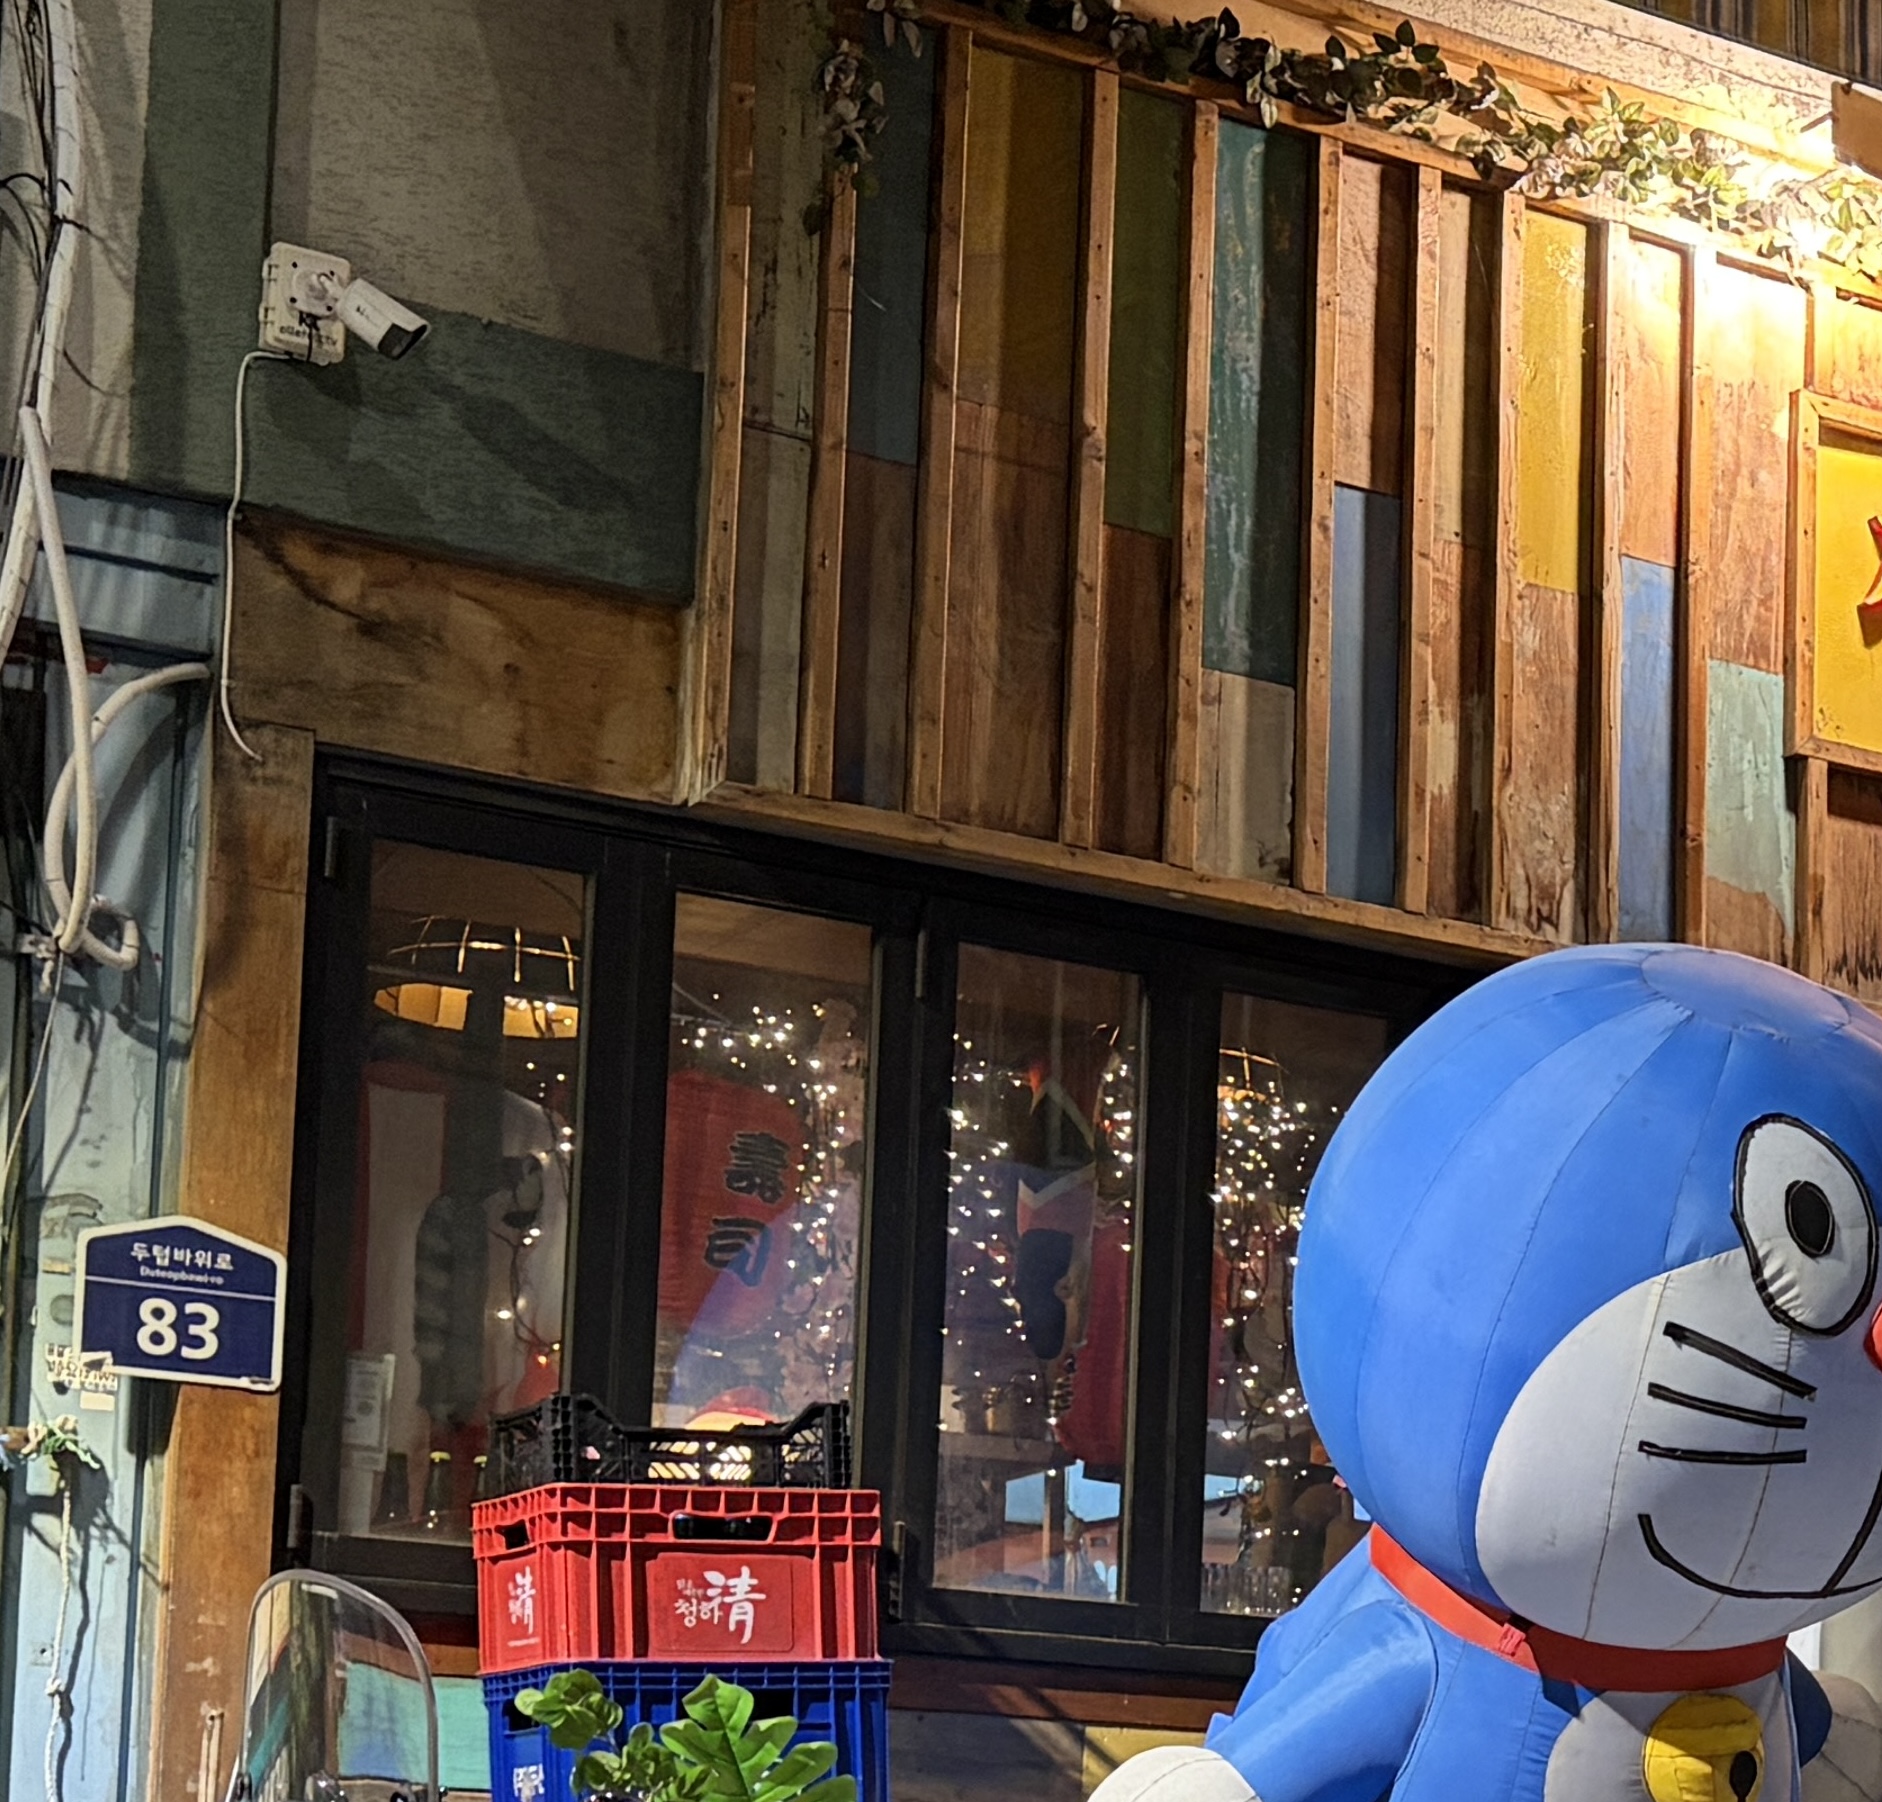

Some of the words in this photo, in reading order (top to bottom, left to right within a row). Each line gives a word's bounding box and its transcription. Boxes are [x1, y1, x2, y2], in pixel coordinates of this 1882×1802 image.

[131, 1242, 234, 1271] 두텁바위로
[136, 1297, 220, 1360] 83
[674, 1597, 724, 1628] 청하
